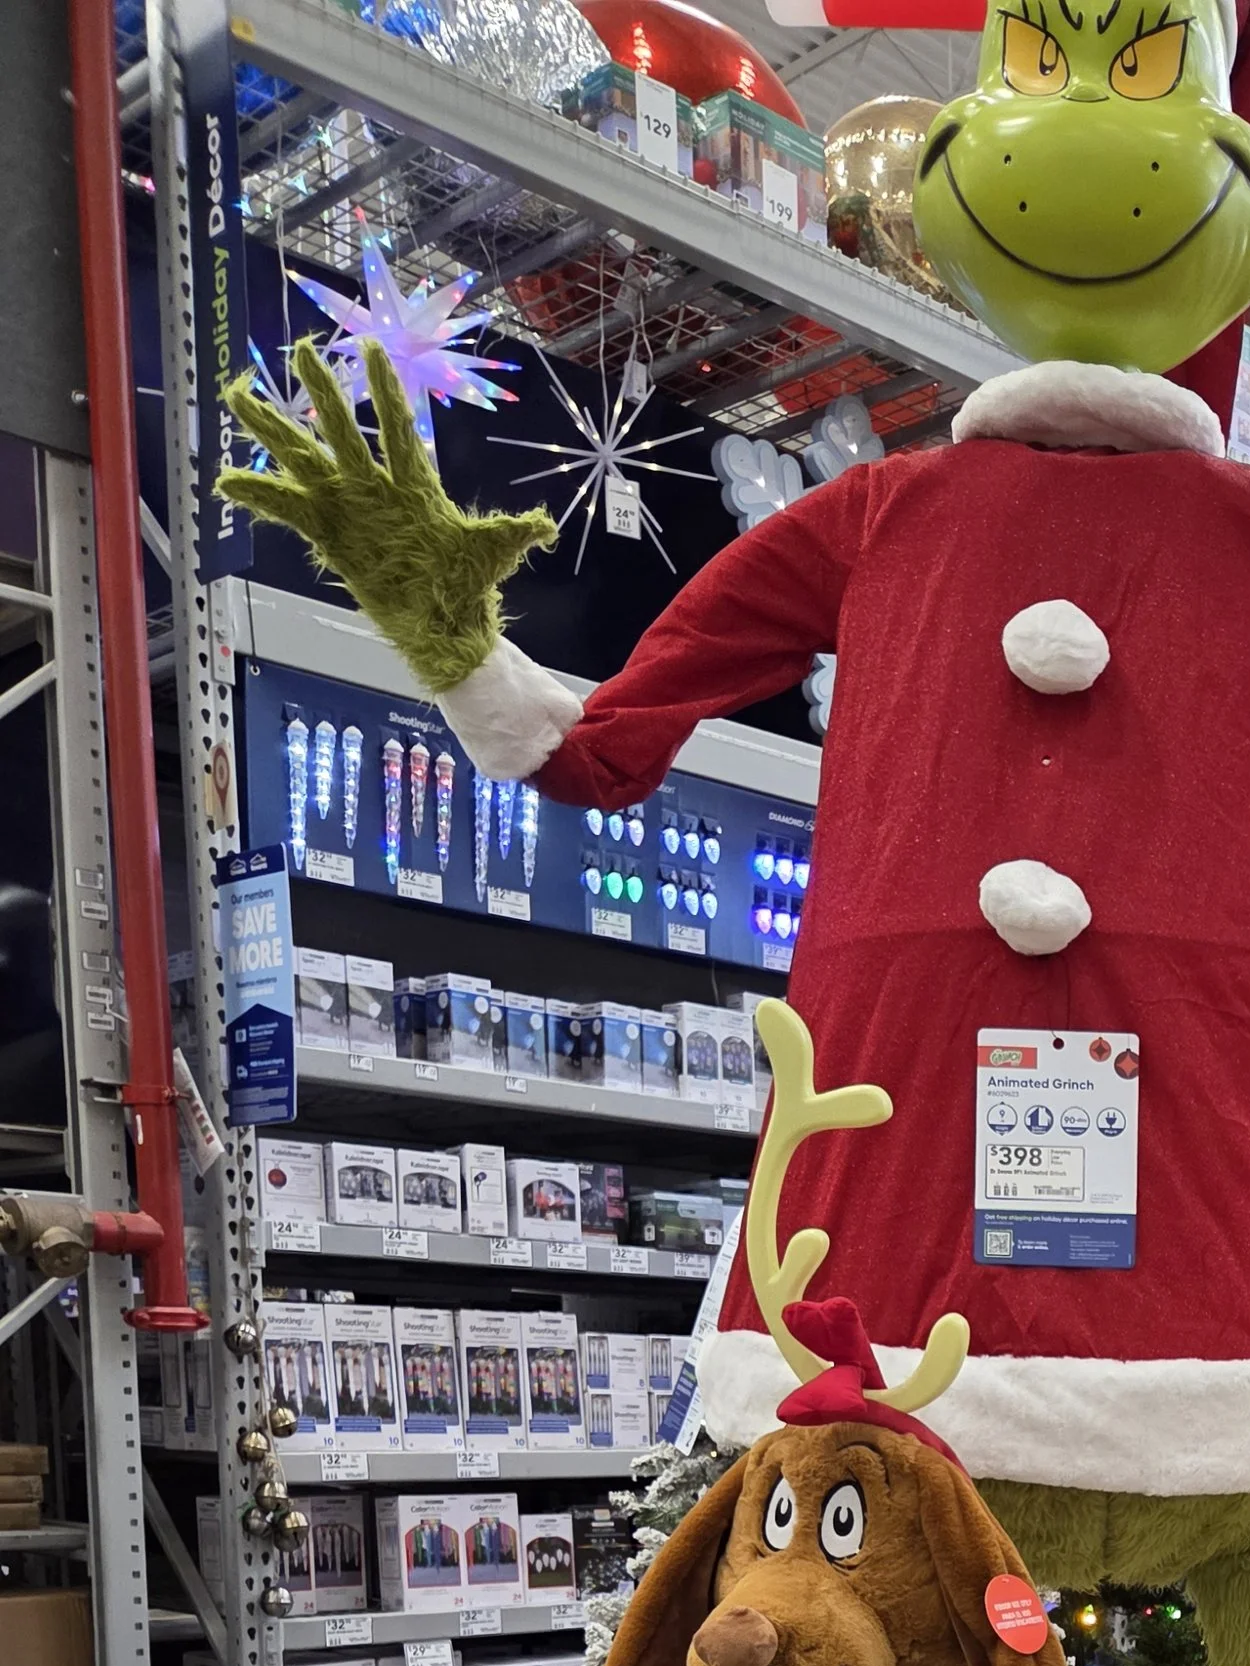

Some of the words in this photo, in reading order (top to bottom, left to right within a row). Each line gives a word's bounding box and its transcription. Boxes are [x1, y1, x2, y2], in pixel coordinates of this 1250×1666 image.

[205, 112, 225, 237] Décor
[211, 246, 232, 403] Holiday
[217, 409, 234, 541] Inoor
[768, 812, 804, 828] DIAMOND
[231, 892, 243, 906] Our
[244, 888, 274, 902] members
[232, 902, 277, 939] SAVE
[229, 936, 283, 974] MORE
[988, 1076, 1049, 1089] Animated
[1052, 1079, 1094, 1091] Grinch
[990, 1146, 1042, 1166] $398
[1009, 1215, 1032, 1223] shipping
[1042, 1215, 1062, 1223] holiday
[323, 1437, 334, 1445] 10
[389, 1437, 399, 1445] 10
[453, 1438, 462, 1446] 10
[515, 1438, 525, 1446] 10
